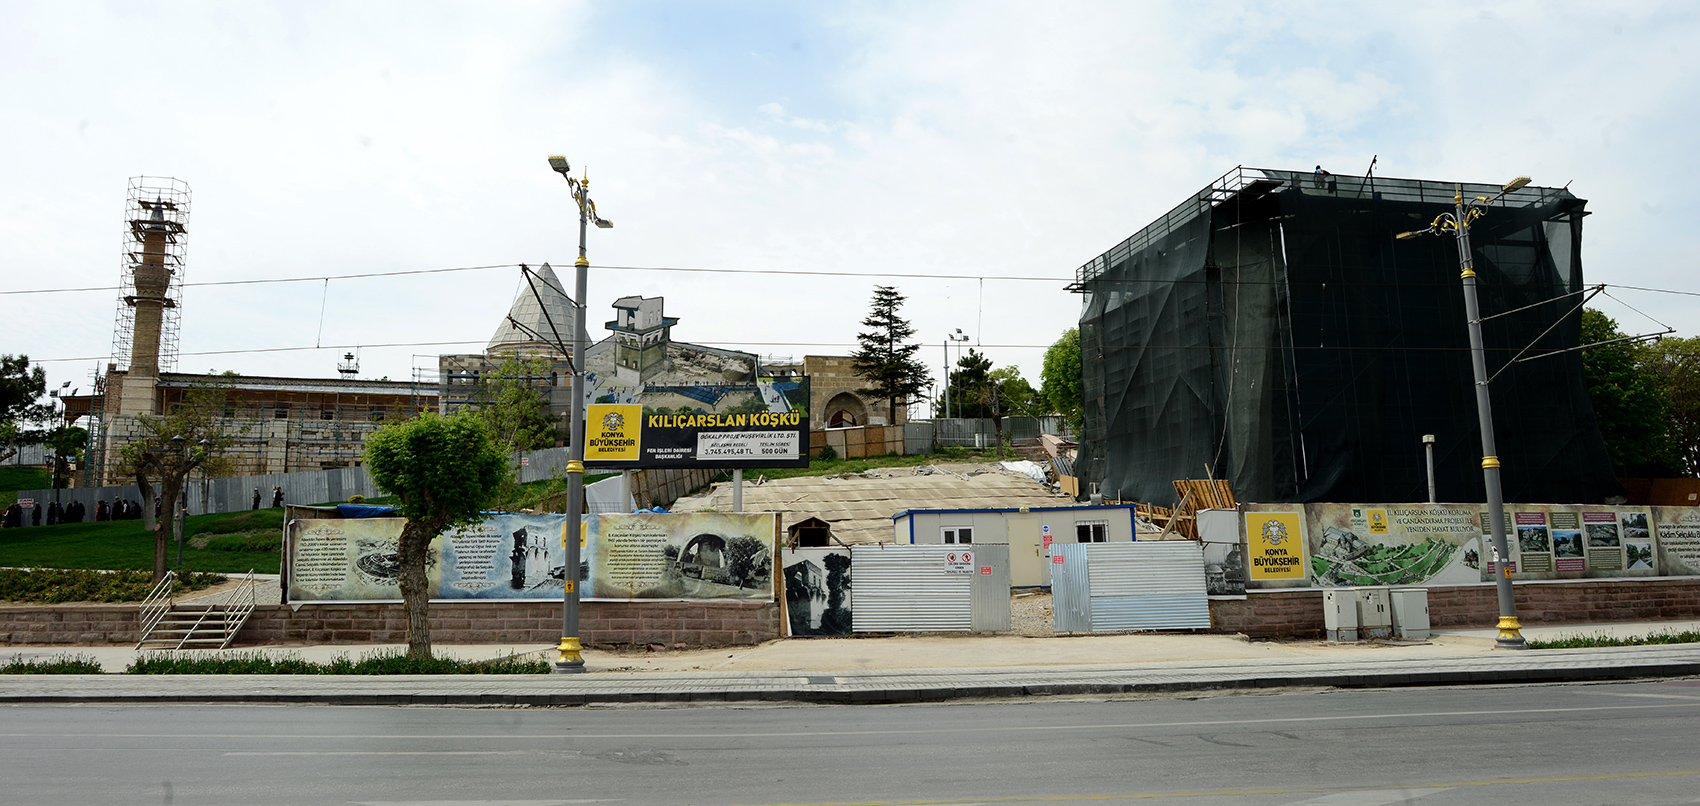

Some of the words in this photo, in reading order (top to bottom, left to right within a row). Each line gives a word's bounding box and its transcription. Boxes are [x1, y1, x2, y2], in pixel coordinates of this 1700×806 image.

[649, 414, 745, 428] KILIÇARSLAN
[750, 410, 800, 427] KÖŞKÜ
[590, 438, 635, 447] BÜYÜKŞEHİR
[1254, 555, 1300, 566] BÜYÜKŞEHİR
